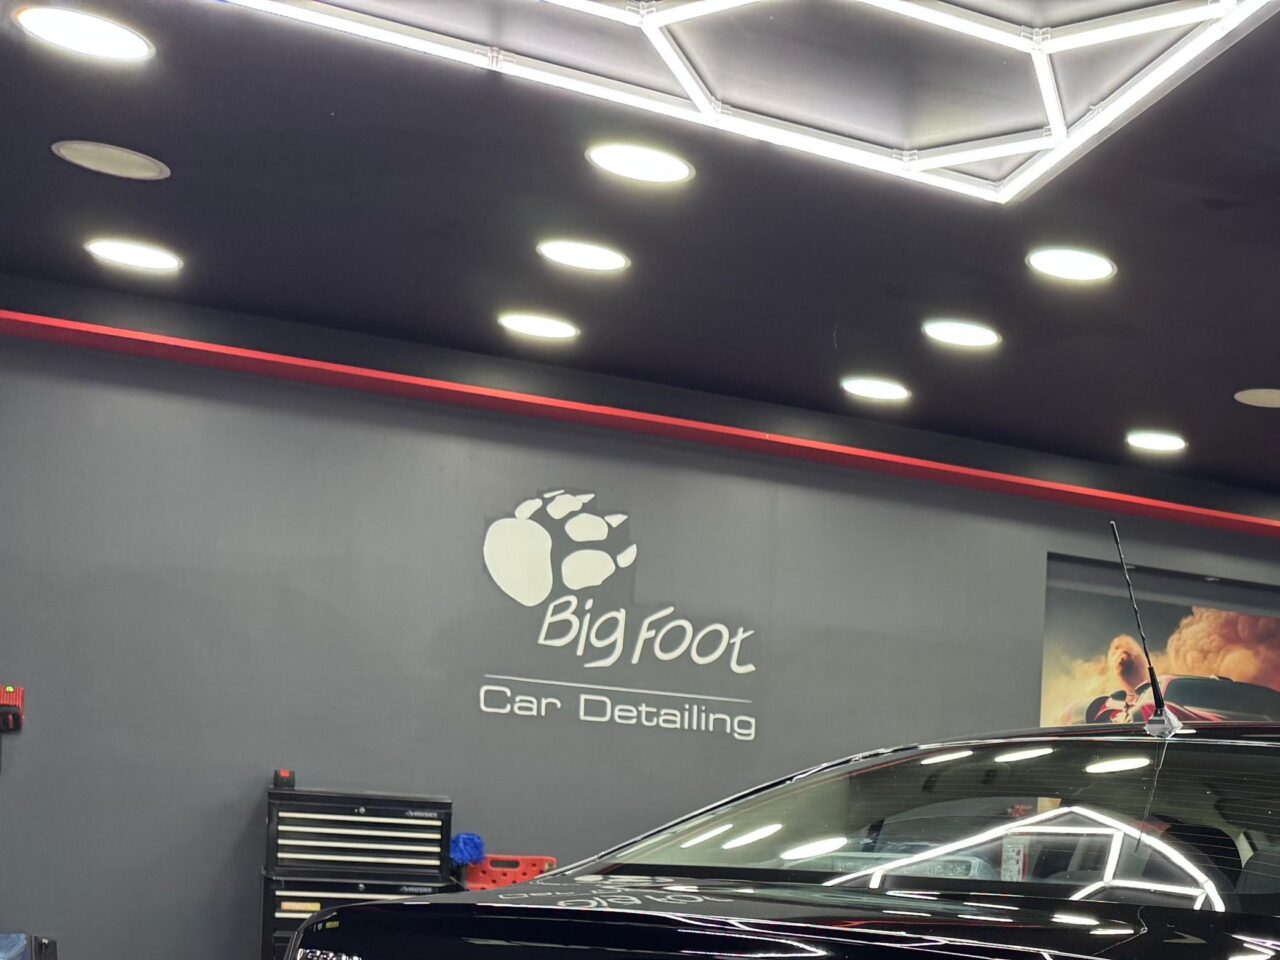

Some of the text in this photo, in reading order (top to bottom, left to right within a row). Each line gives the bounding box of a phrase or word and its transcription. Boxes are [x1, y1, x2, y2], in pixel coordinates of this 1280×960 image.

[537, 595, 626, 668] Big
[479, 685, 756, 741] Car Detailing
